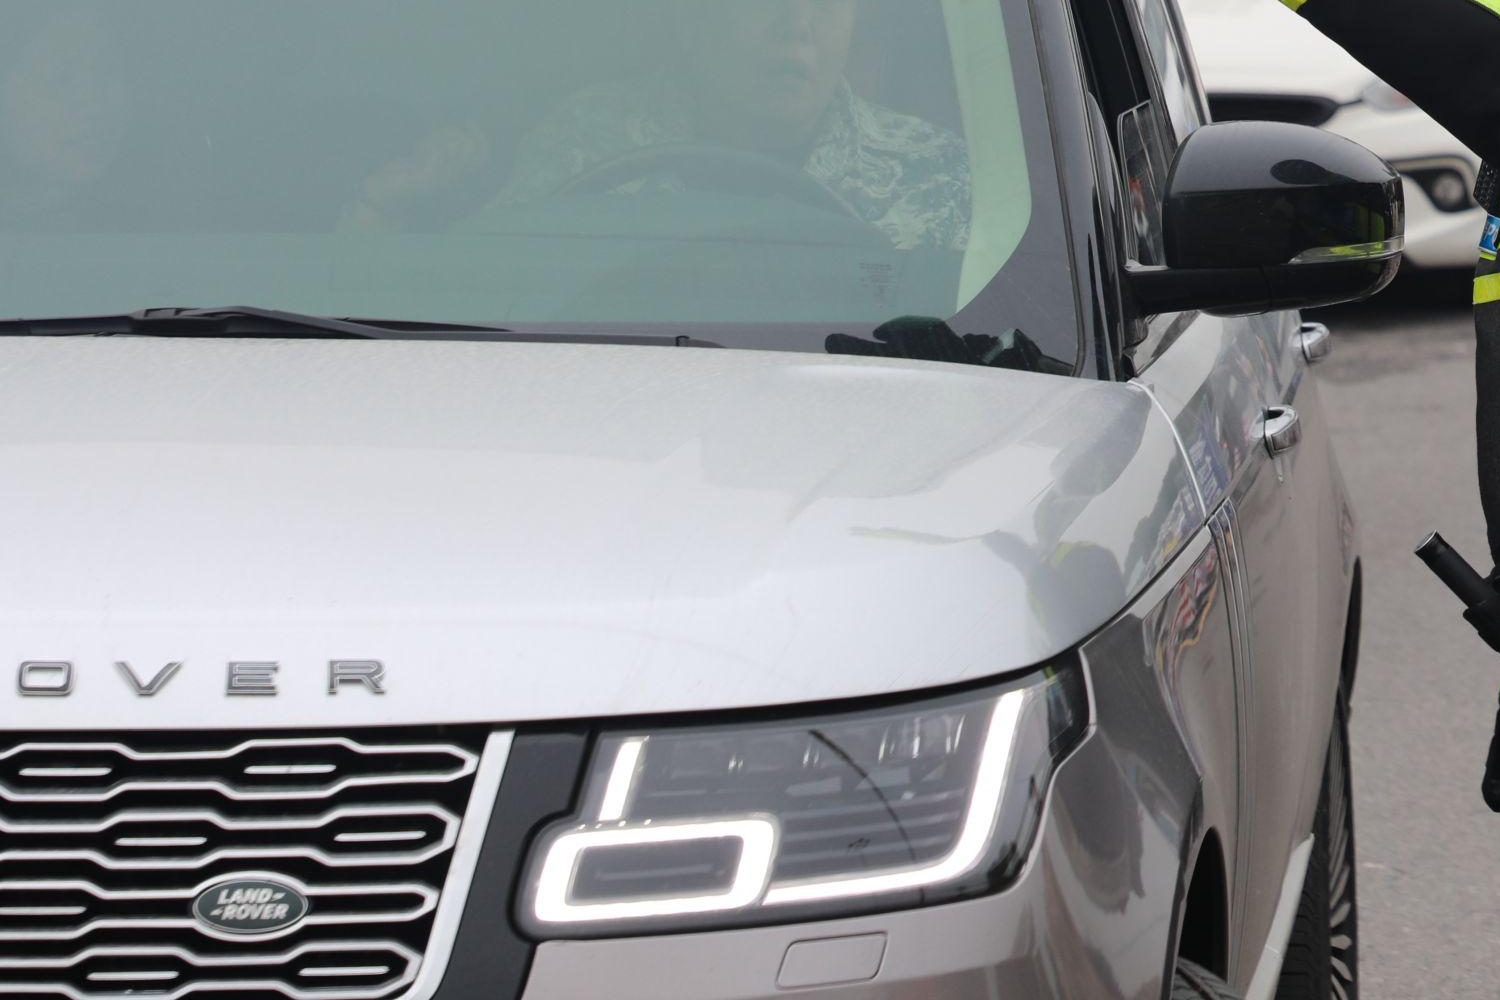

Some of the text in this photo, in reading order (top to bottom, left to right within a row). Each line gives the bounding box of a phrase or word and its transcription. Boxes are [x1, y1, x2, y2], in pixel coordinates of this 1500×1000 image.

[16, 659, 387, 696] OVER
[217, 887, 274, 905] LAND
[220, 903, 290, 921] ROVER
